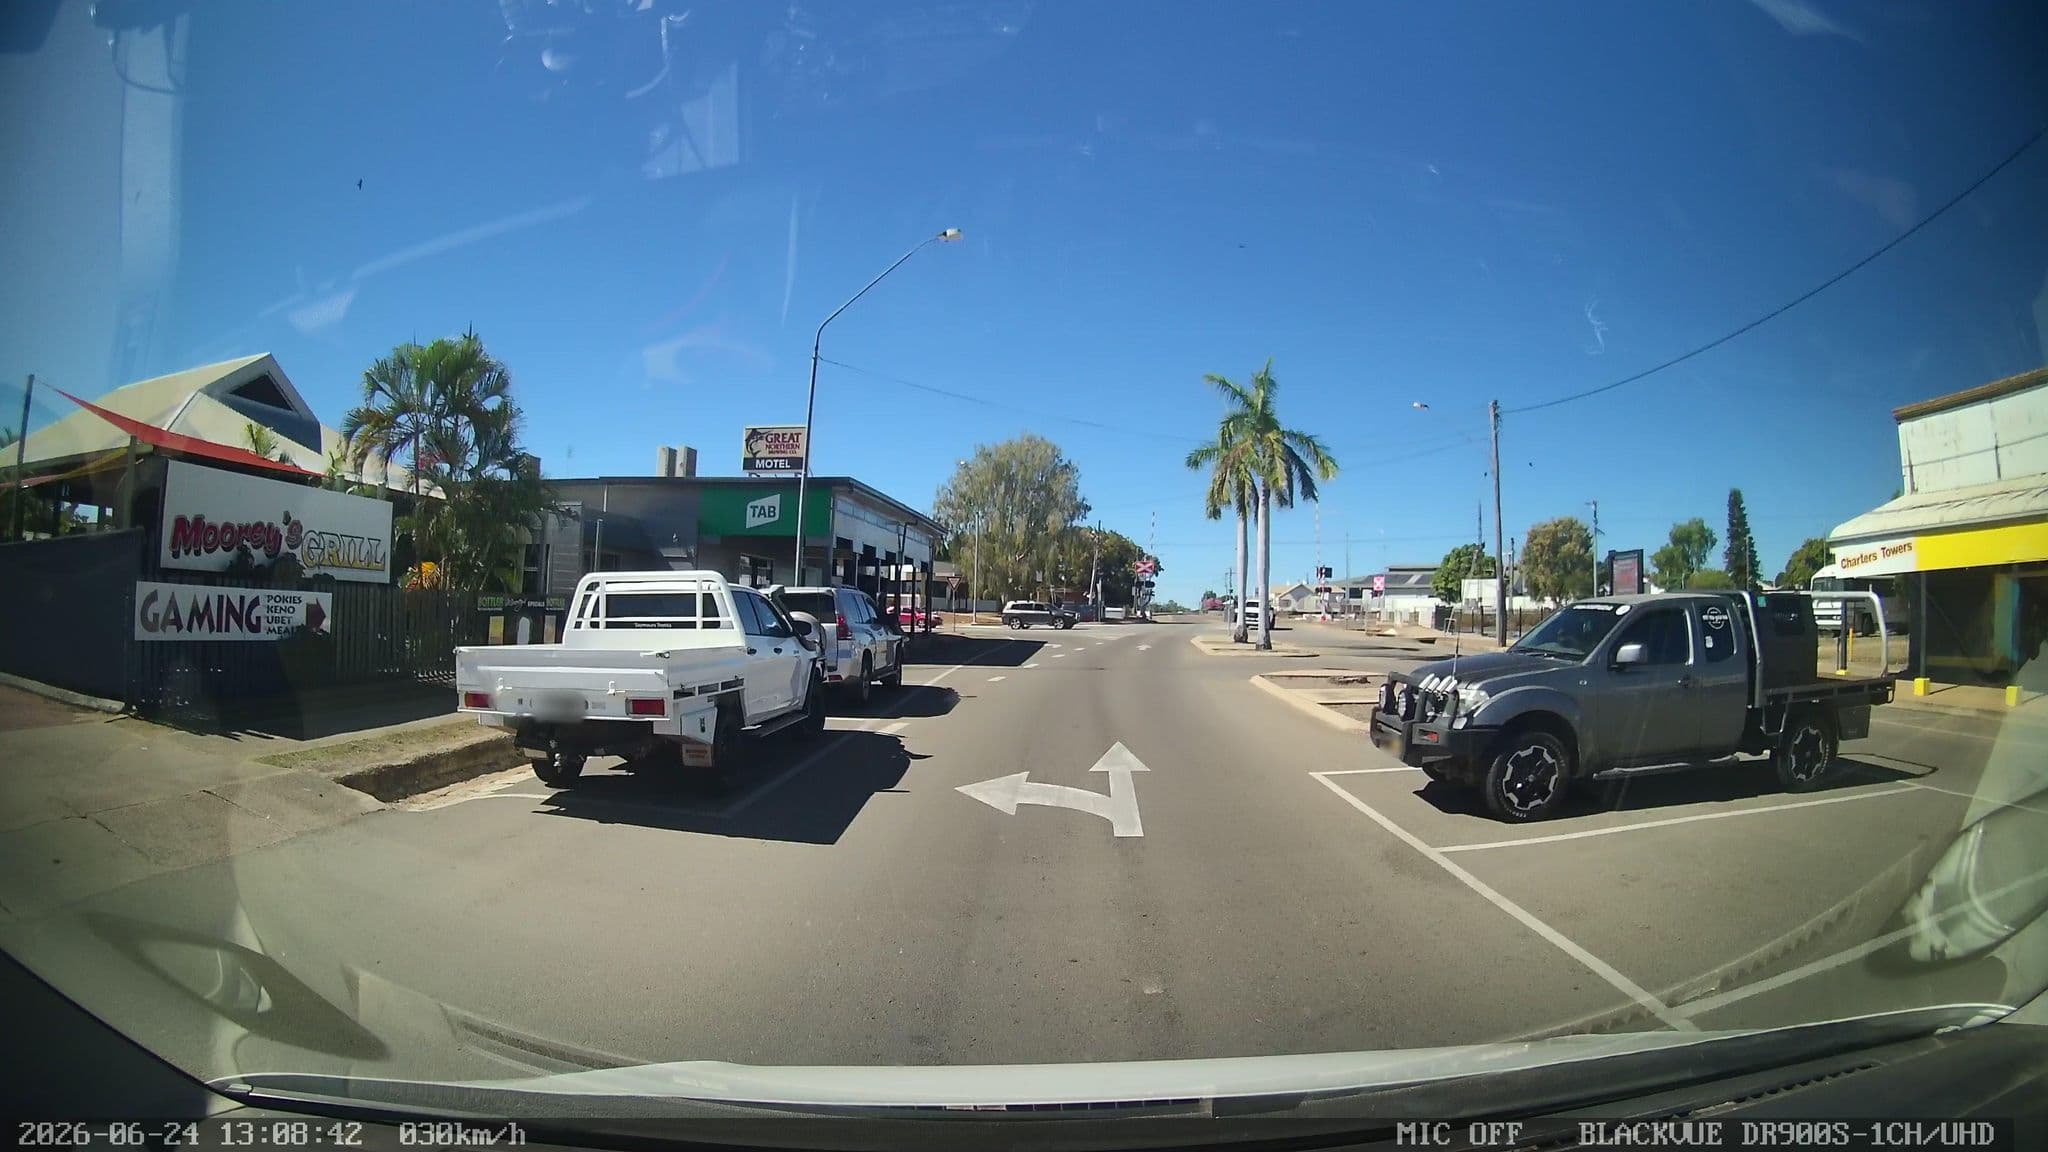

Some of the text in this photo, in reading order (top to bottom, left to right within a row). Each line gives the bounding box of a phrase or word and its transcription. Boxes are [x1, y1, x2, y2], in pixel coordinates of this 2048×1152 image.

[765, 432, 802, 444] GREAT
[755, 459, 791, 469] MOTEL
[750, 505, 777, 518] TAB
[170, 510, 386, 571] Moorey's GRILL
[1840, 542, 1913, 569] Charters Towers
[266, 594, 302, 604] POKIES
[140, 589, 262, 634] GAMING
[266, 605, 296, 614] KENO
[266, 615, 293, 624] UBET
[266, 625, 297, 635] MEAL
